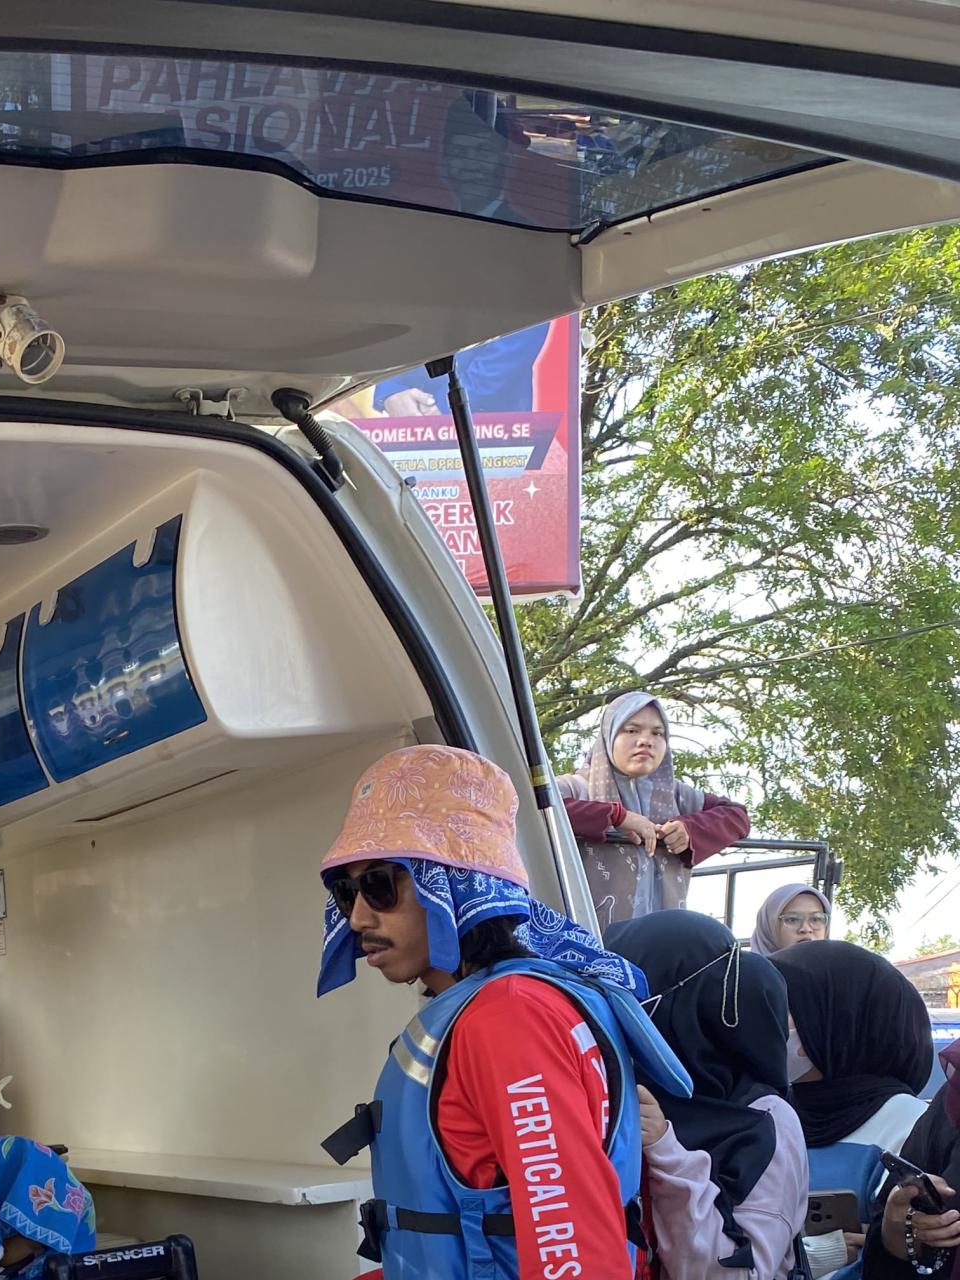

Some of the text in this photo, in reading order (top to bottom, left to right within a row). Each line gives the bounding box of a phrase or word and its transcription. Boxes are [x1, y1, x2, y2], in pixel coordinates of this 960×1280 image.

[97, 57, 442, 112] PAHLAW
[182, 98, 431, 153] SIONAL
[343, 164, 391, 188] 2025
[437, 424, 509, 441] GIING,
[511, 422, 531, 438] SE
[392, 458, 427, 472] ETUA
[482, 455, 528, 469] NGKAT
[424, 501, 514, 527] GERK
[506, 1073, 569, 1222] VERTICAL
[83, 1245, 165, 1266] SPENCER
